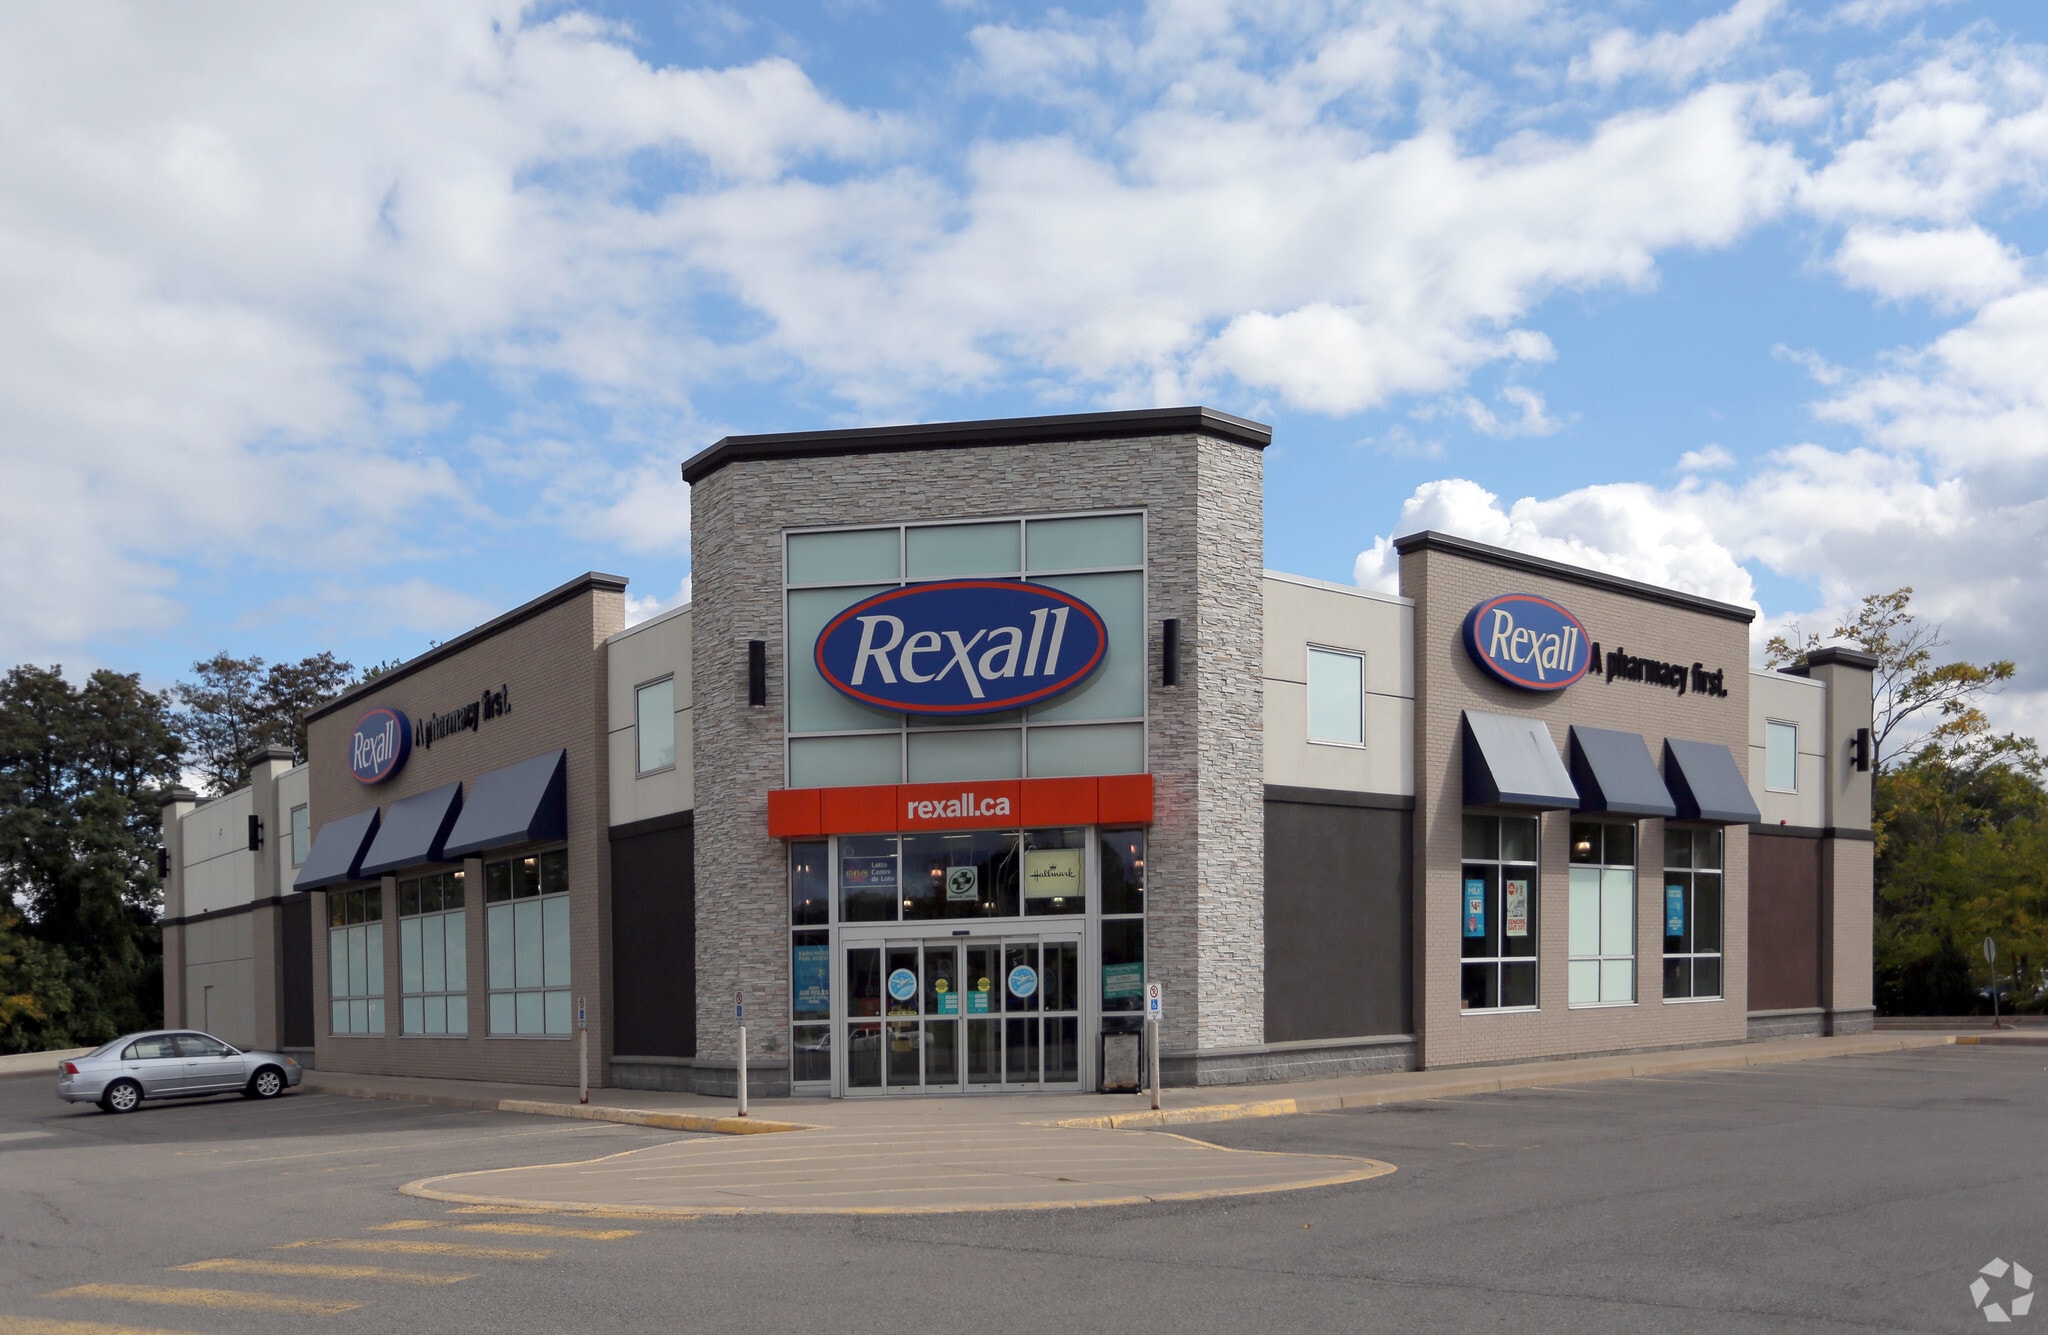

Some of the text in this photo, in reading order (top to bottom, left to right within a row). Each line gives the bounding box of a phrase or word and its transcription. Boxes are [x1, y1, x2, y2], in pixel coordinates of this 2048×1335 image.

[851, 607, 1069, 698] Rexall
[1489, 608, 1578, 680] Rexall
[1588, 642, 1728, 697] A pharmacy first.
[415, 683, 511, 749] A pharmacy first.
[353, 719, 394, 774] Rexall
[907, 793, 1010, 819] rexall.ca
[1029, 868, 1077, 883] Hallmark
